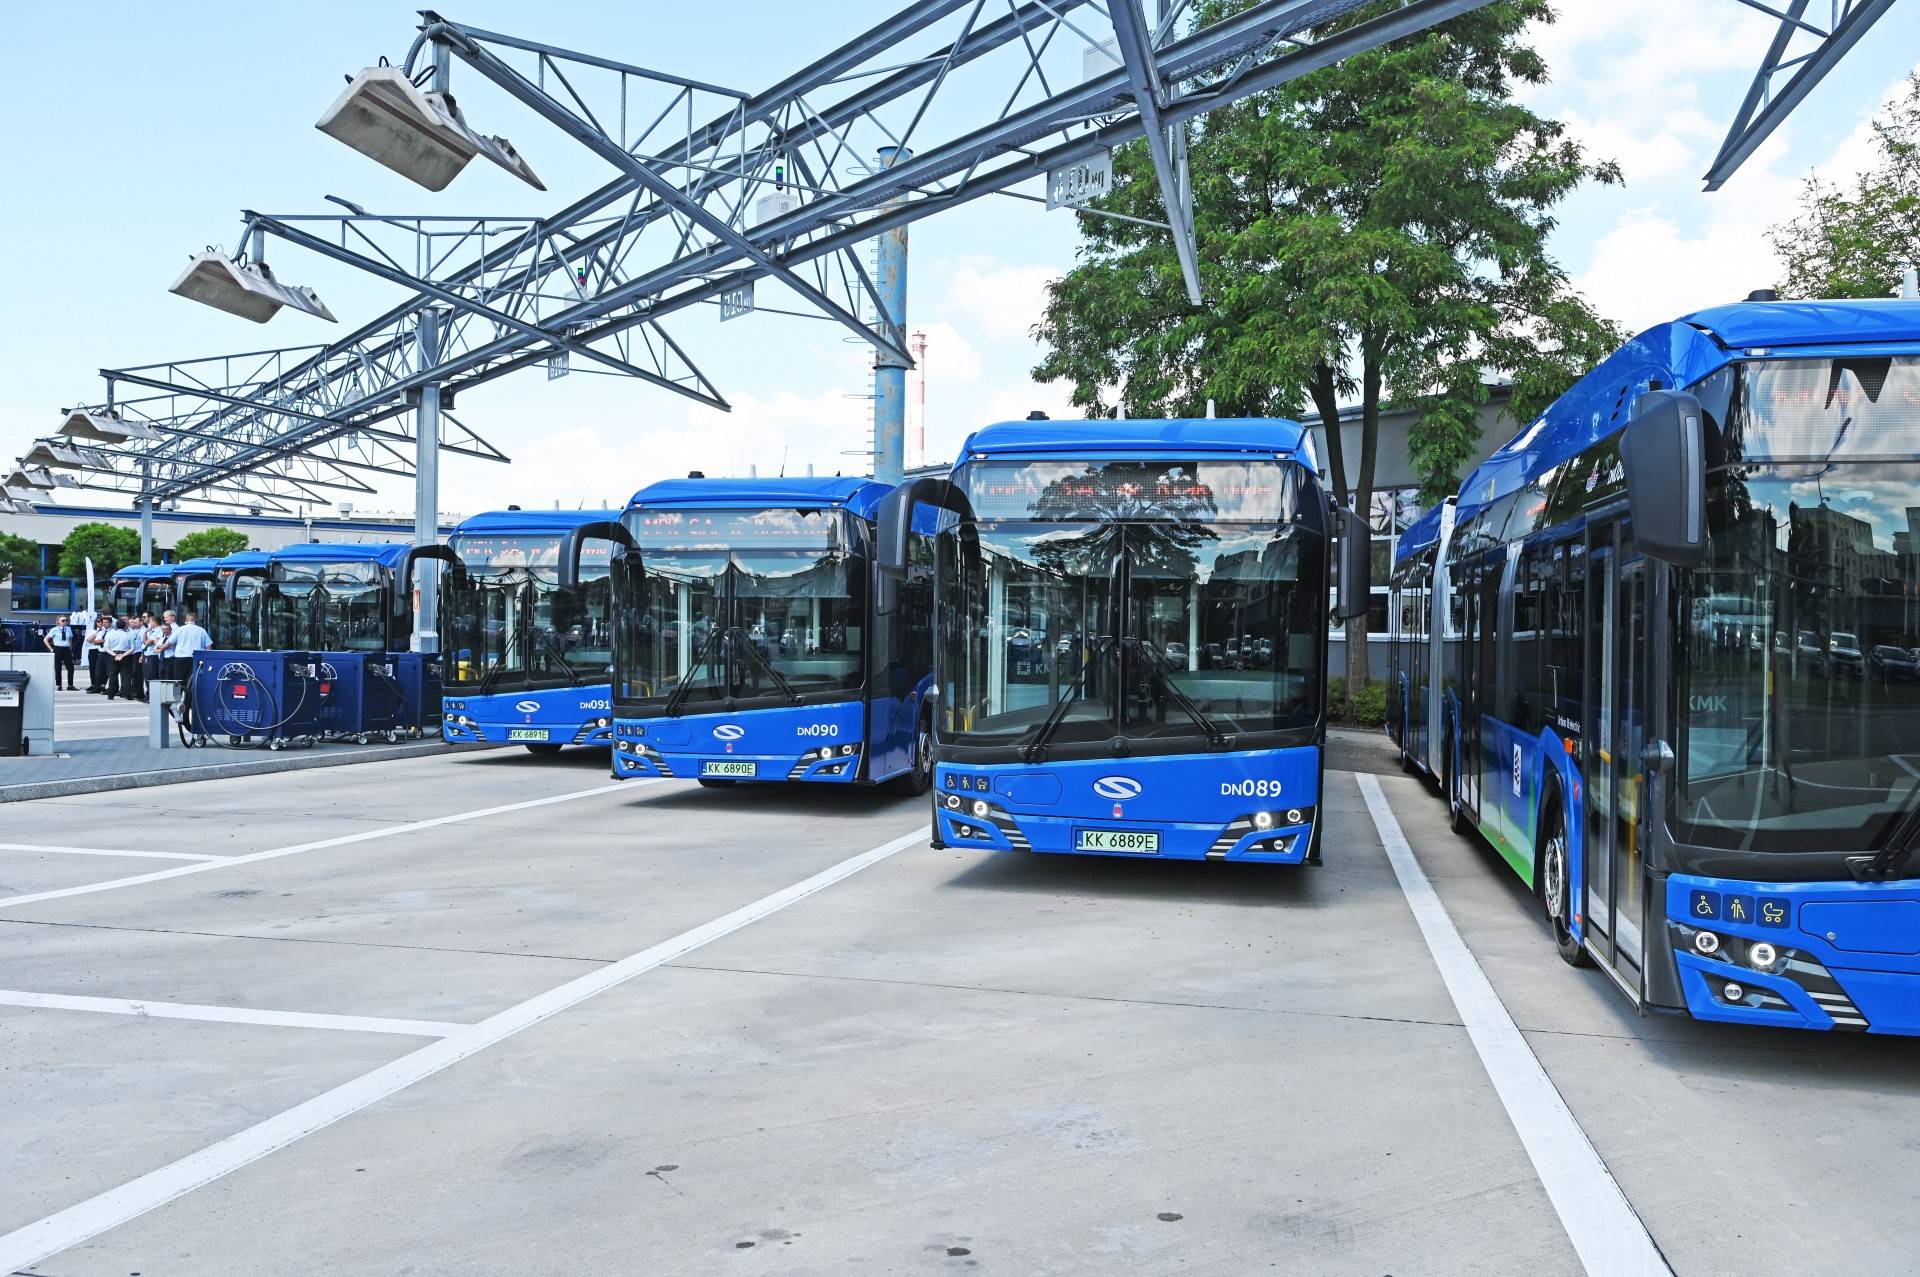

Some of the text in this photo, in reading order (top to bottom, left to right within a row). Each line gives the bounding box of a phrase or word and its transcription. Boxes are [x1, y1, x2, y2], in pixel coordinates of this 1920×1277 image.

[579, 700, 611, 710] DN091
[512, 731, 547, 739] KK 6891E
[797, 723, 838, 737] DN090
[708, 763, 753, 774] KK 6890E
[1221, 779, 1282, 797] DN089
[1085, 832, 1154, 849] KK 6889E
